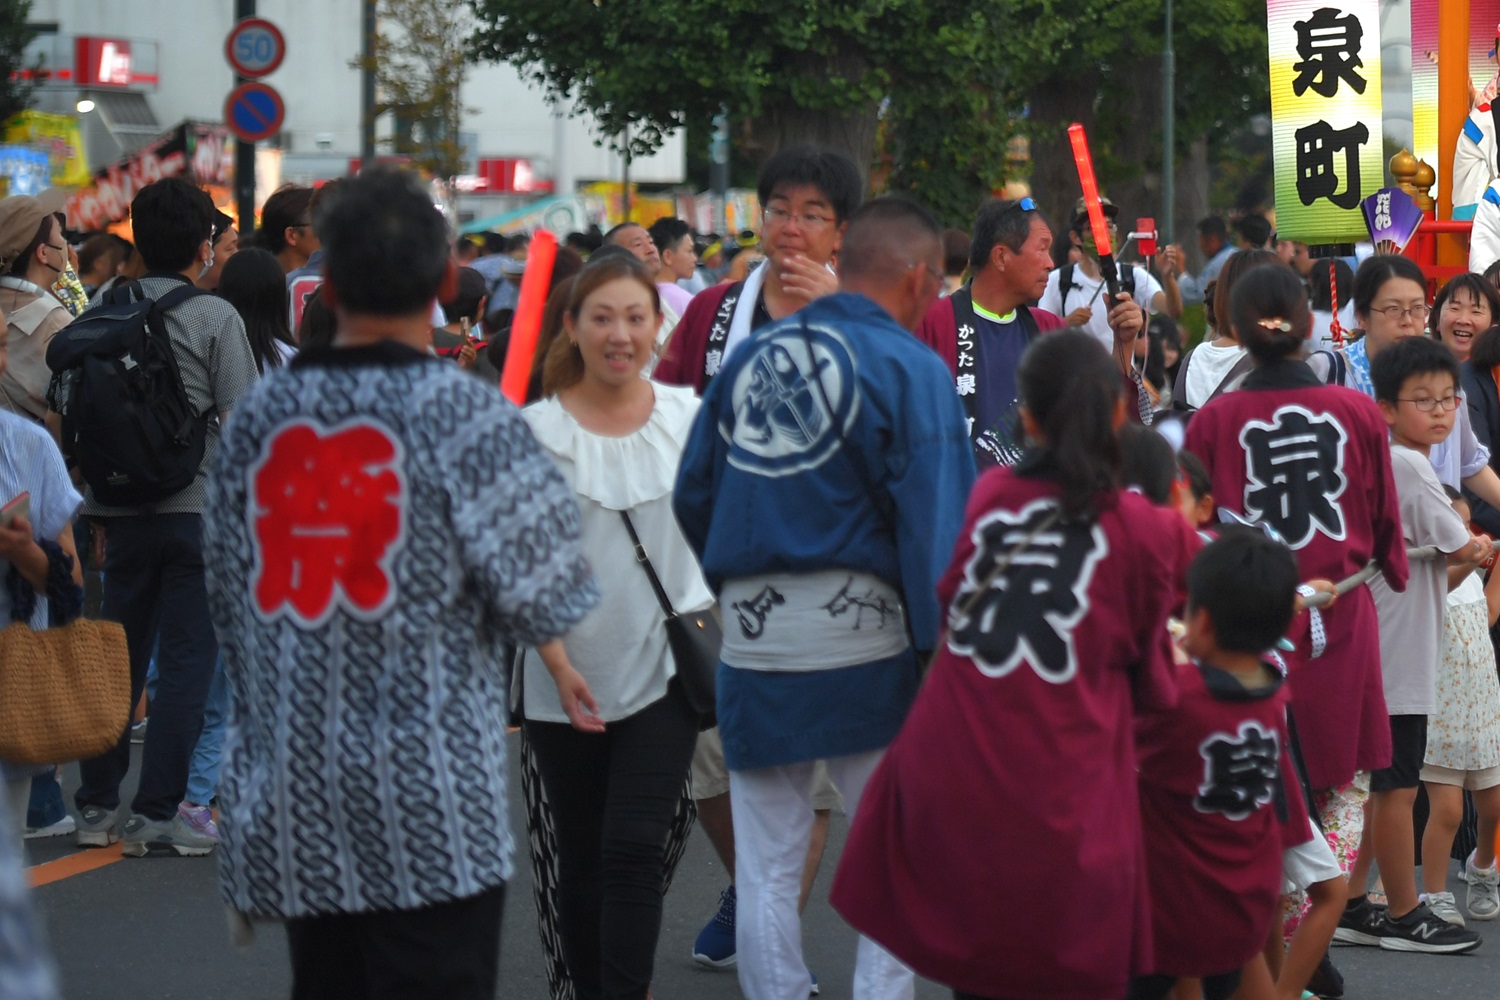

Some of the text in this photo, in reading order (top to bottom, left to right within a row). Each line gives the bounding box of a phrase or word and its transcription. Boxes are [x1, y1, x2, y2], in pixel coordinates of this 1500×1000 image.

[237, 33, 275, 62] 50
[1293, 8, 1369, 210] 泉町
[955, 374, 977, 396] 泉
[957, 324, 975, 368] かつた
[1239, 405, 1347, 550] 泉
[948, 500, 1109, 684] 泉
